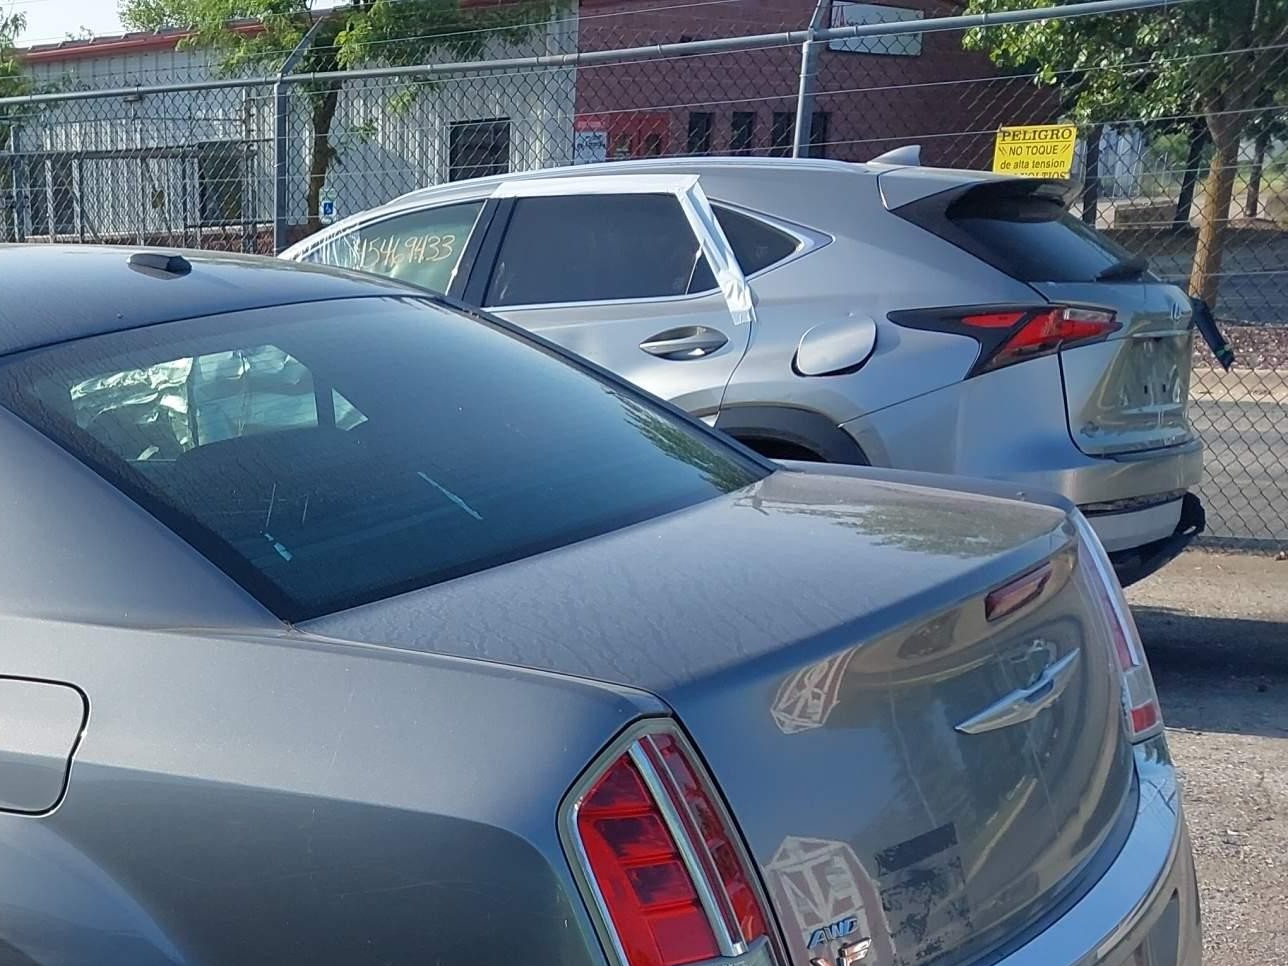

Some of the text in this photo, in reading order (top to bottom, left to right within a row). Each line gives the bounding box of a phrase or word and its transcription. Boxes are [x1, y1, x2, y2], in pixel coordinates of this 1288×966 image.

[1000, 128, 1073, 142] PELIGRO
[1008, 144, 1059, 156] NO TOQUE
[1000, 160, 1012, 170] de
[1013, 159, 1030, 170] alta
[807, 916, 858, 950] AWD
